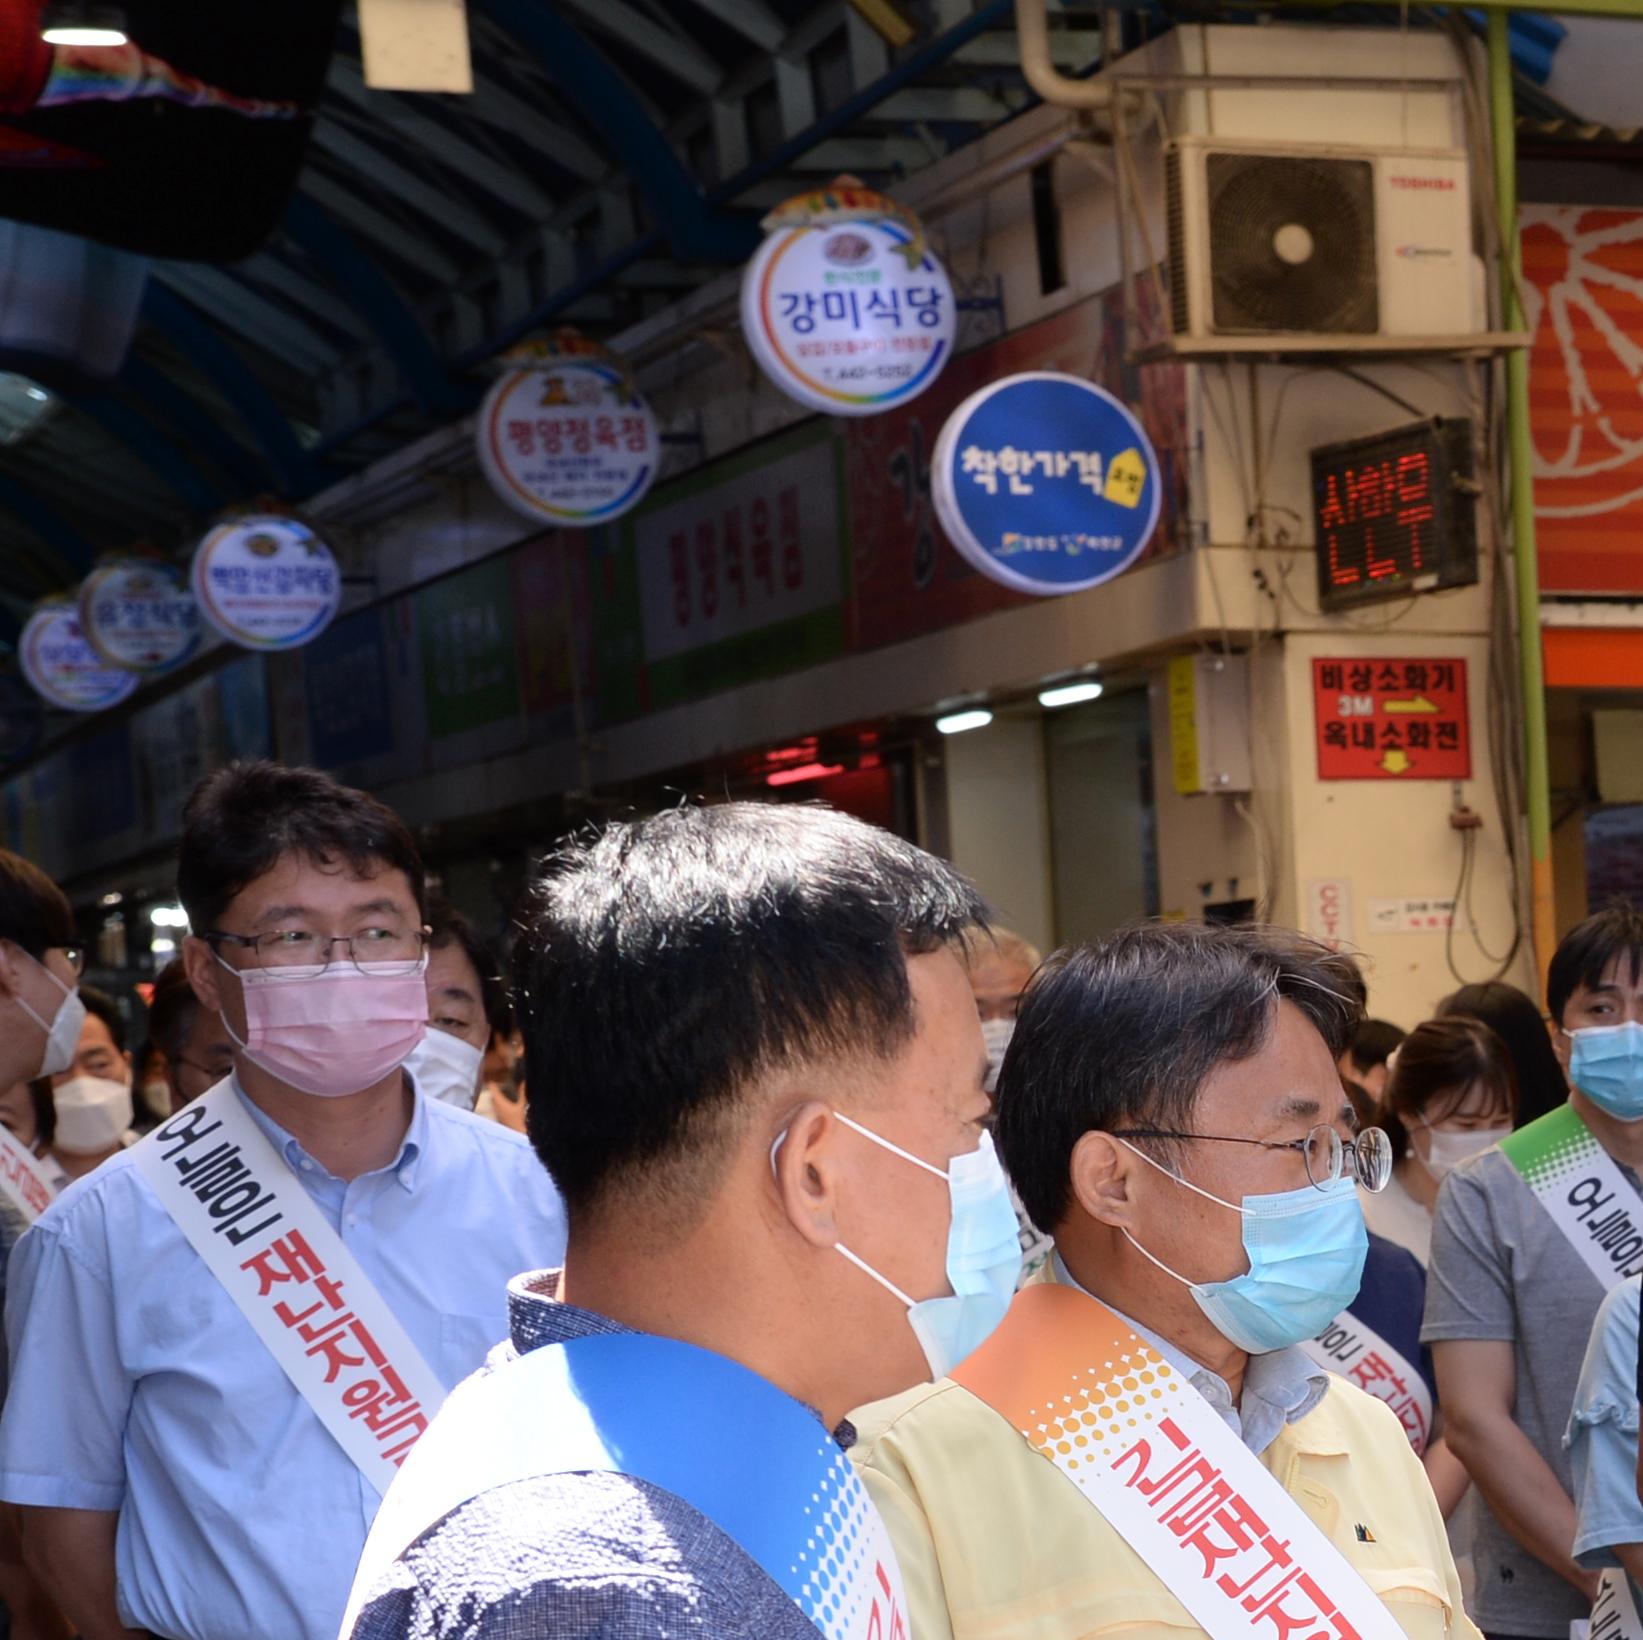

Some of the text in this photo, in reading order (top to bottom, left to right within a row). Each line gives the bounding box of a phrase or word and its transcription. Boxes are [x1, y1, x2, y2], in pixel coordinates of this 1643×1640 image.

[1390, 175, 1457, 192] TOSHIBA
[780, 286, 944, 334] 강미식당
[961, 445, 1103, 496] 착한가격
[1320, 663, 1456, 692] 비상소화기
[1337, 695, 1375, 717] 3M
[1324, 720, 1460, 751] 옥내소화전
[155, 1105, 284, 1247] 오늘은
